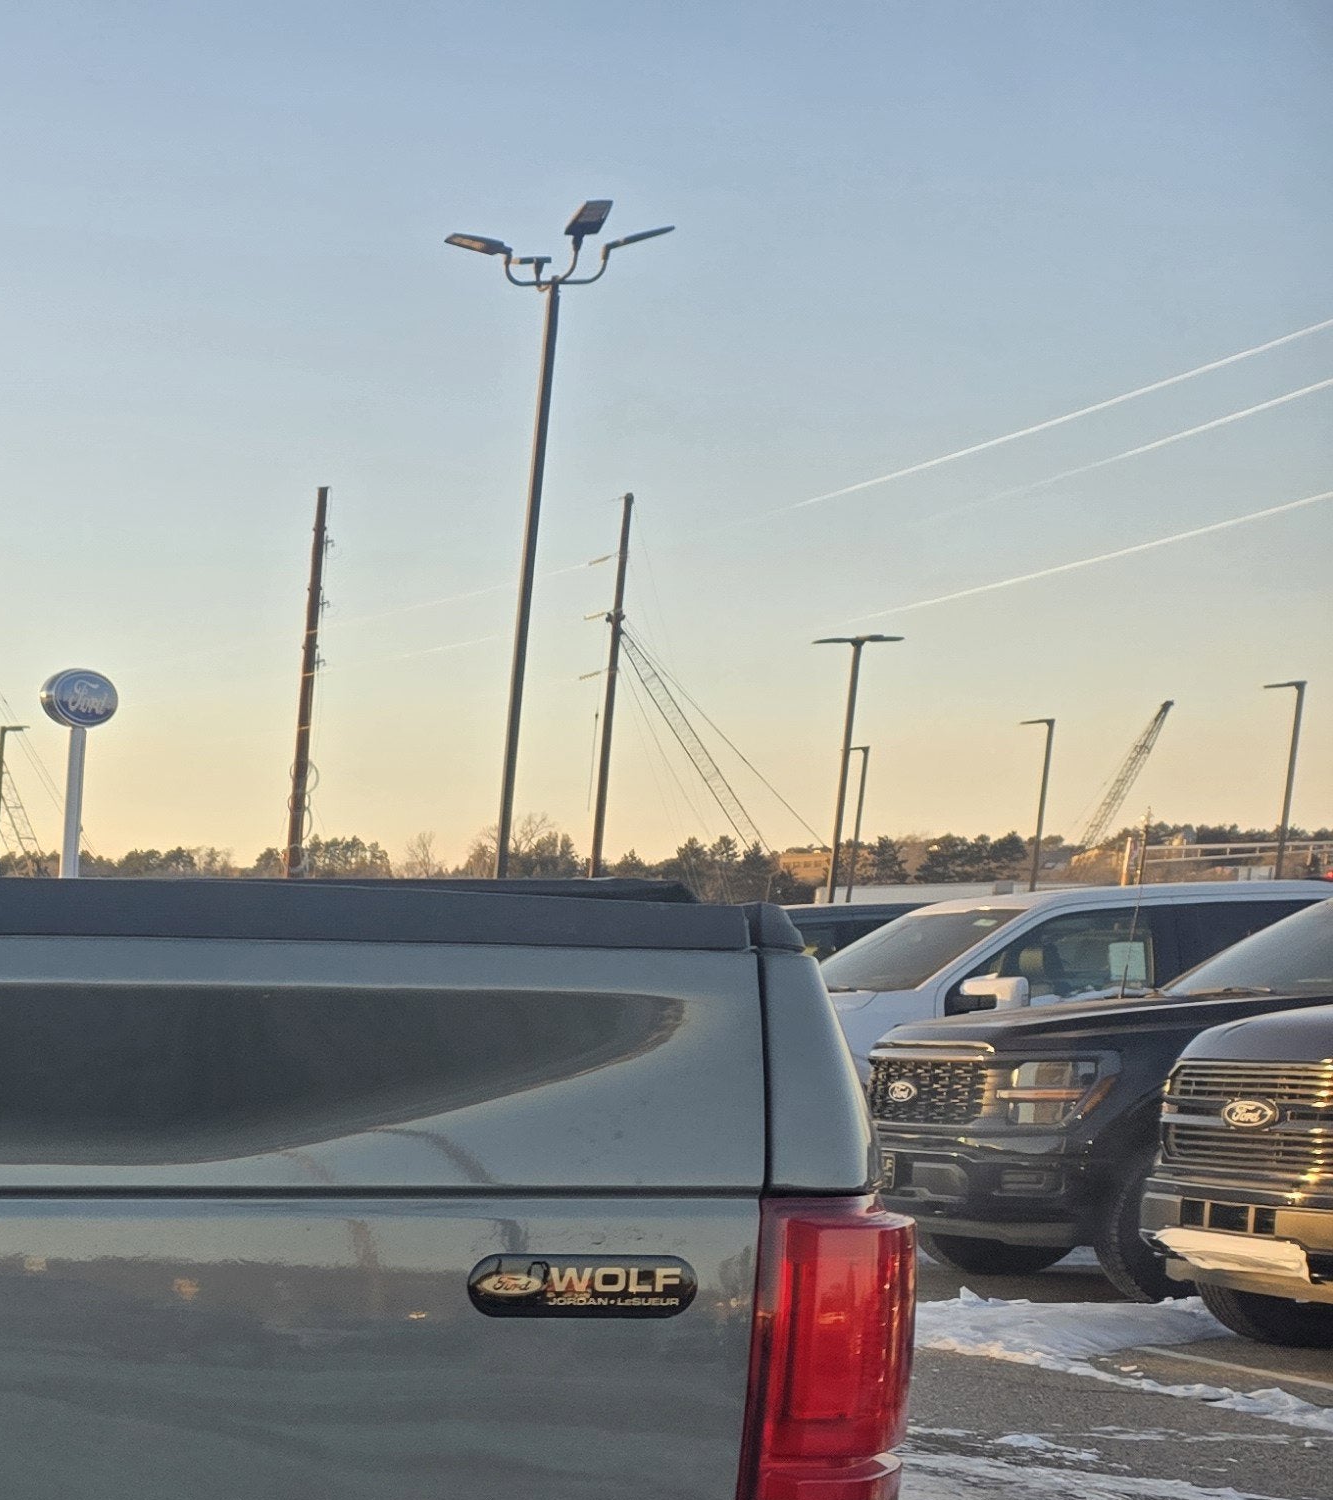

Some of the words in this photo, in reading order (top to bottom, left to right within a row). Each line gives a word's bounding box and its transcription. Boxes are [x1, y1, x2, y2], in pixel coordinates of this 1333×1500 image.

[68, 680, 108, 715] Ford
[549, 1267, 682, 1292] WOLF
[547, 1297, 609, 1306] JORDAN
